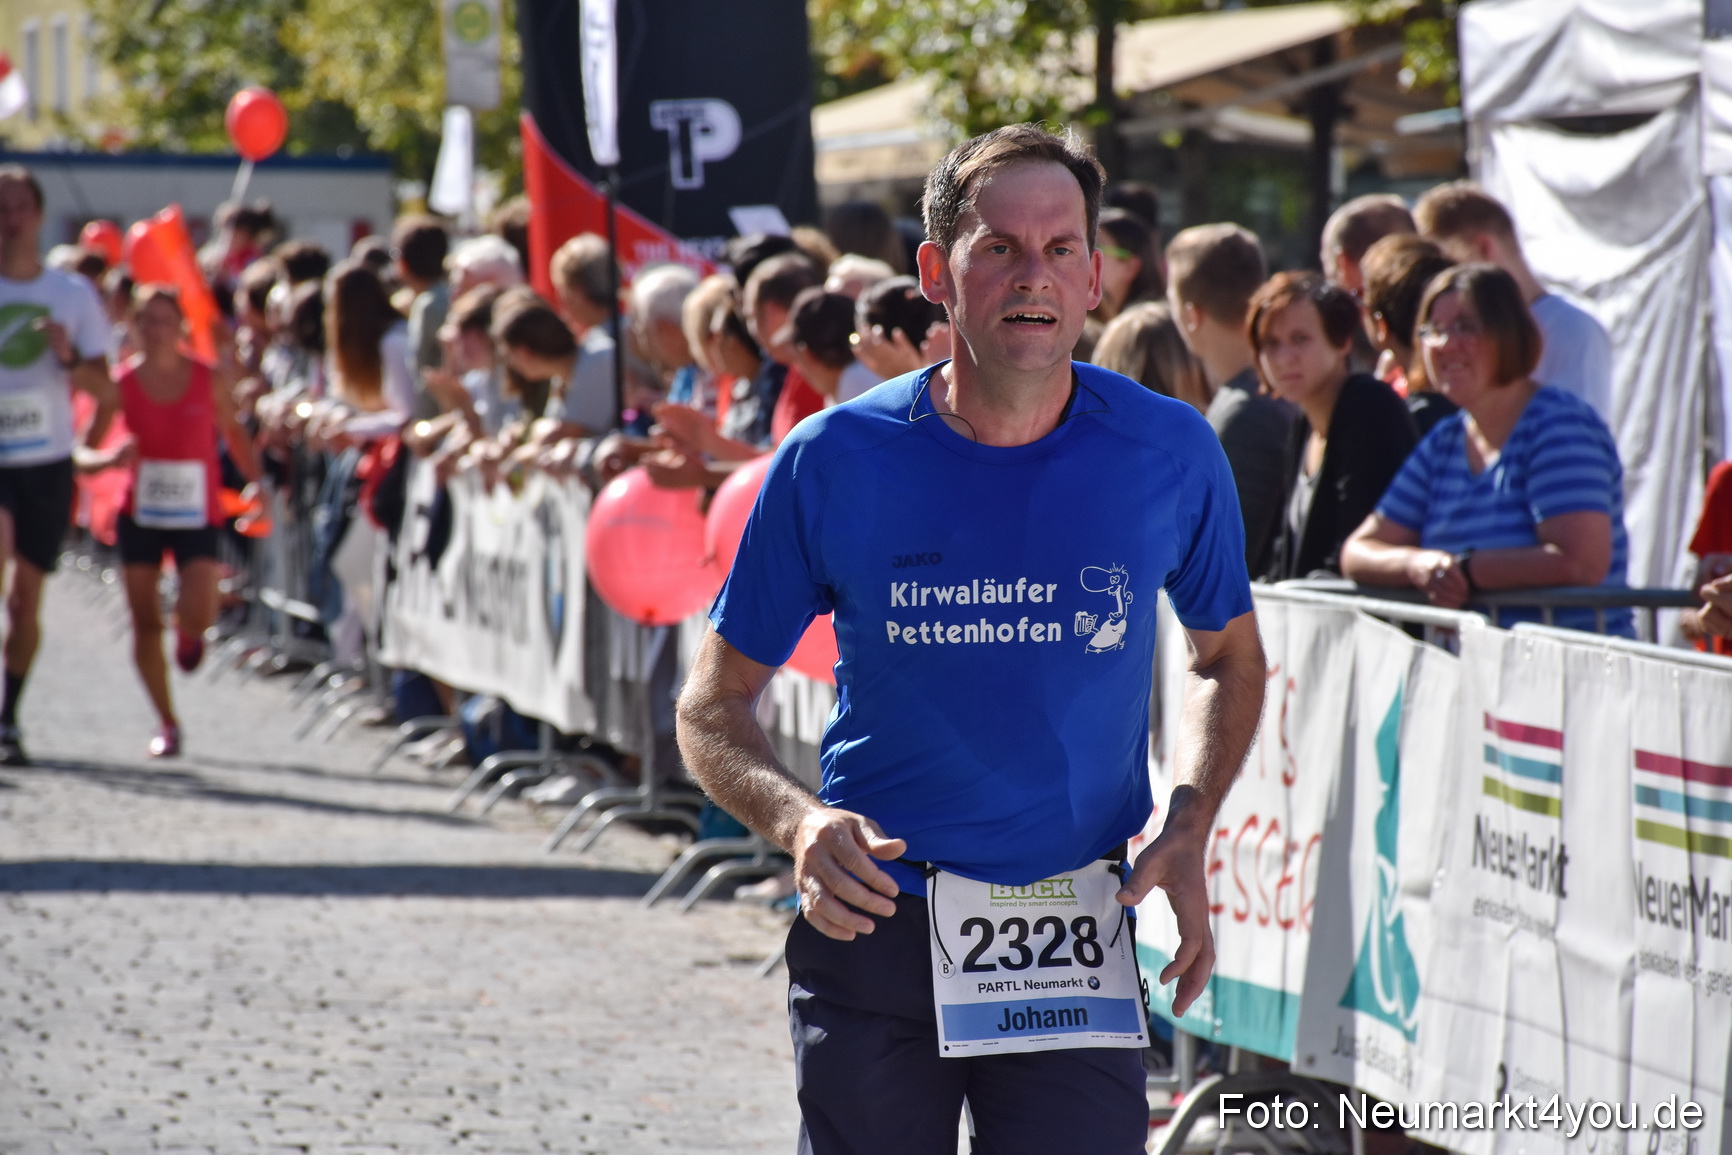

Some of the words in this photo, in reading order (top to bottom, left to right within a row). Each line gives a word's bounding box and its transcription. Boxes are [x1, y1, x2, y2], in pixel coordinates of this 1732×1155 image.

[649, 97, 742, 189] TP
[892, 552, 943, 568] JAKO
[891, 577, 1058, 607] Kirwaläufer
[886, 616, 1062, 645] Pettenhofen
[989, 900, 1018, 908] inspired
[1018, 900, 1027, 908] by
[1049, 899, 1078, 907] concepts
[1633, 861, 1732, 941] NeuerMar
[960, 916, 1104, 973] 2328
[943, 963, 949, 974] B
[978, 981, 1021, 993] PARTL
[1024, 977, 1084, 990] Neumarkt
[998, 1006, 1088, 1032] Johann
